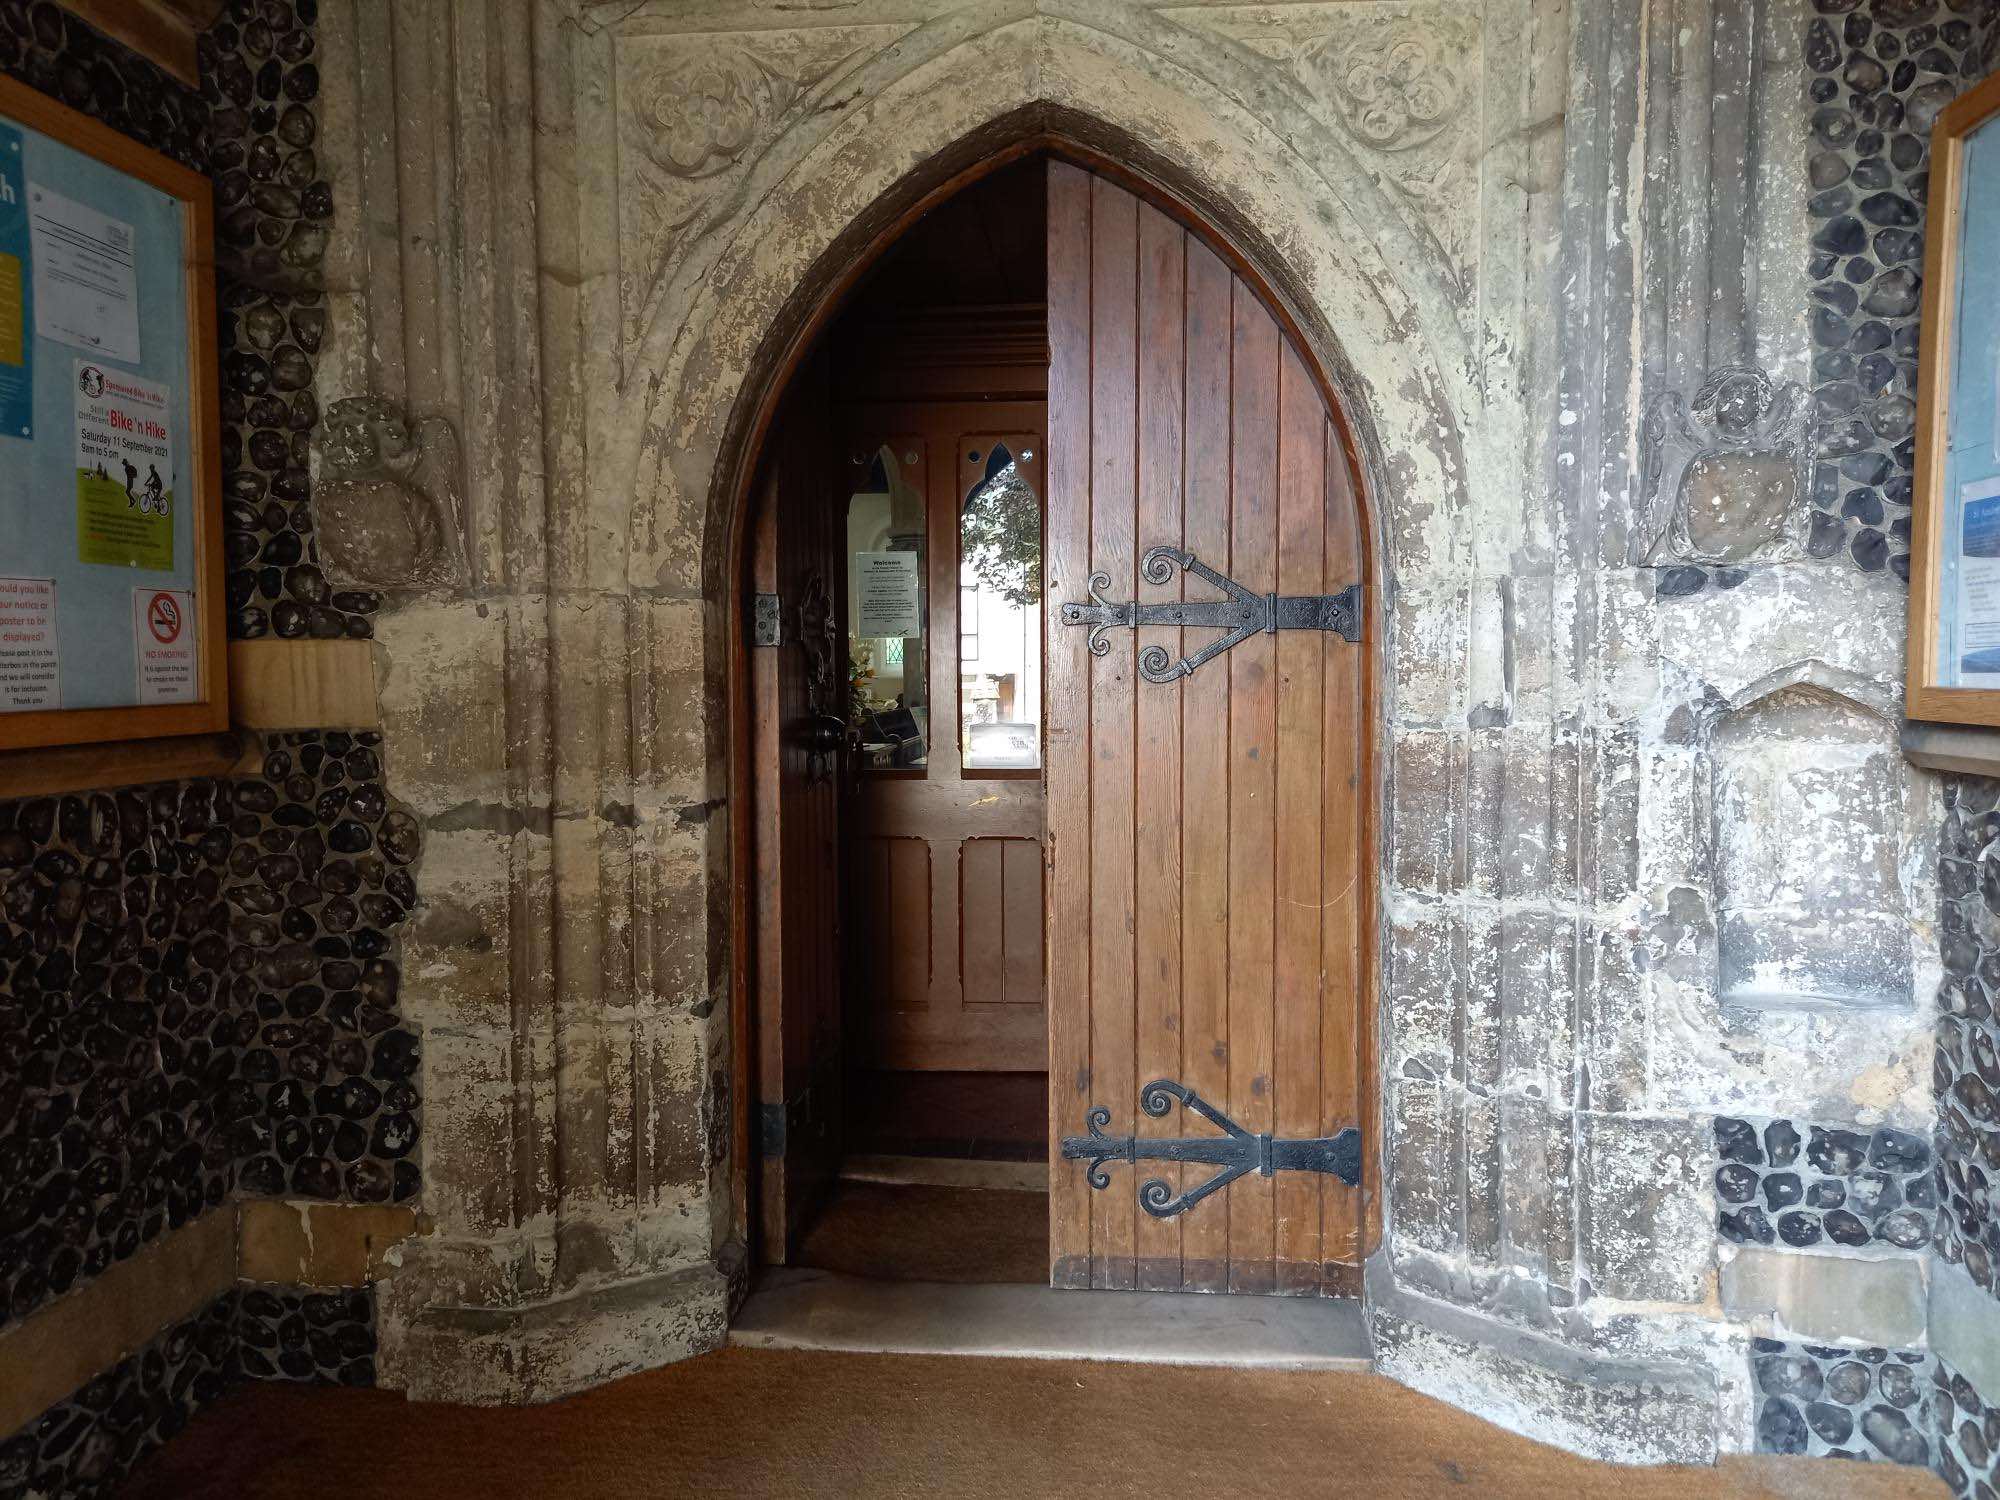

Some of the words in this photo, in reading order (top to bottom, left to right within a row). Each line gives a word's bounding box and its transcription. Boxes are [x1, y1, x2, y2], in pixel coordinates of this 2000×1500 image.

[78, 410, 109, 426] Different
[110, 409, 133, 432] Bike
[145, 420, 167, 440] Hike
[81, 428, 112, 447] Saturday
[113, 436, 120, 447] 11
[121, 437, 154, 454] September
[154, 445, 168, 457] 2021
[81, 443, 95, 454] 9am
[96, 445, 102, 456] to
[0, 583, 17, 592] ould
[19, 585, 34, 596] you
[36, 583, 49, 593] like
[0, 601, 12, 609] our
[15, 600, 40, 609] notice
[27, 617, 35, 625] to
[17, 649, 30, 658] post
[157, 650, 187, 659] SMOKING
[20, 672, 31, 680] will
